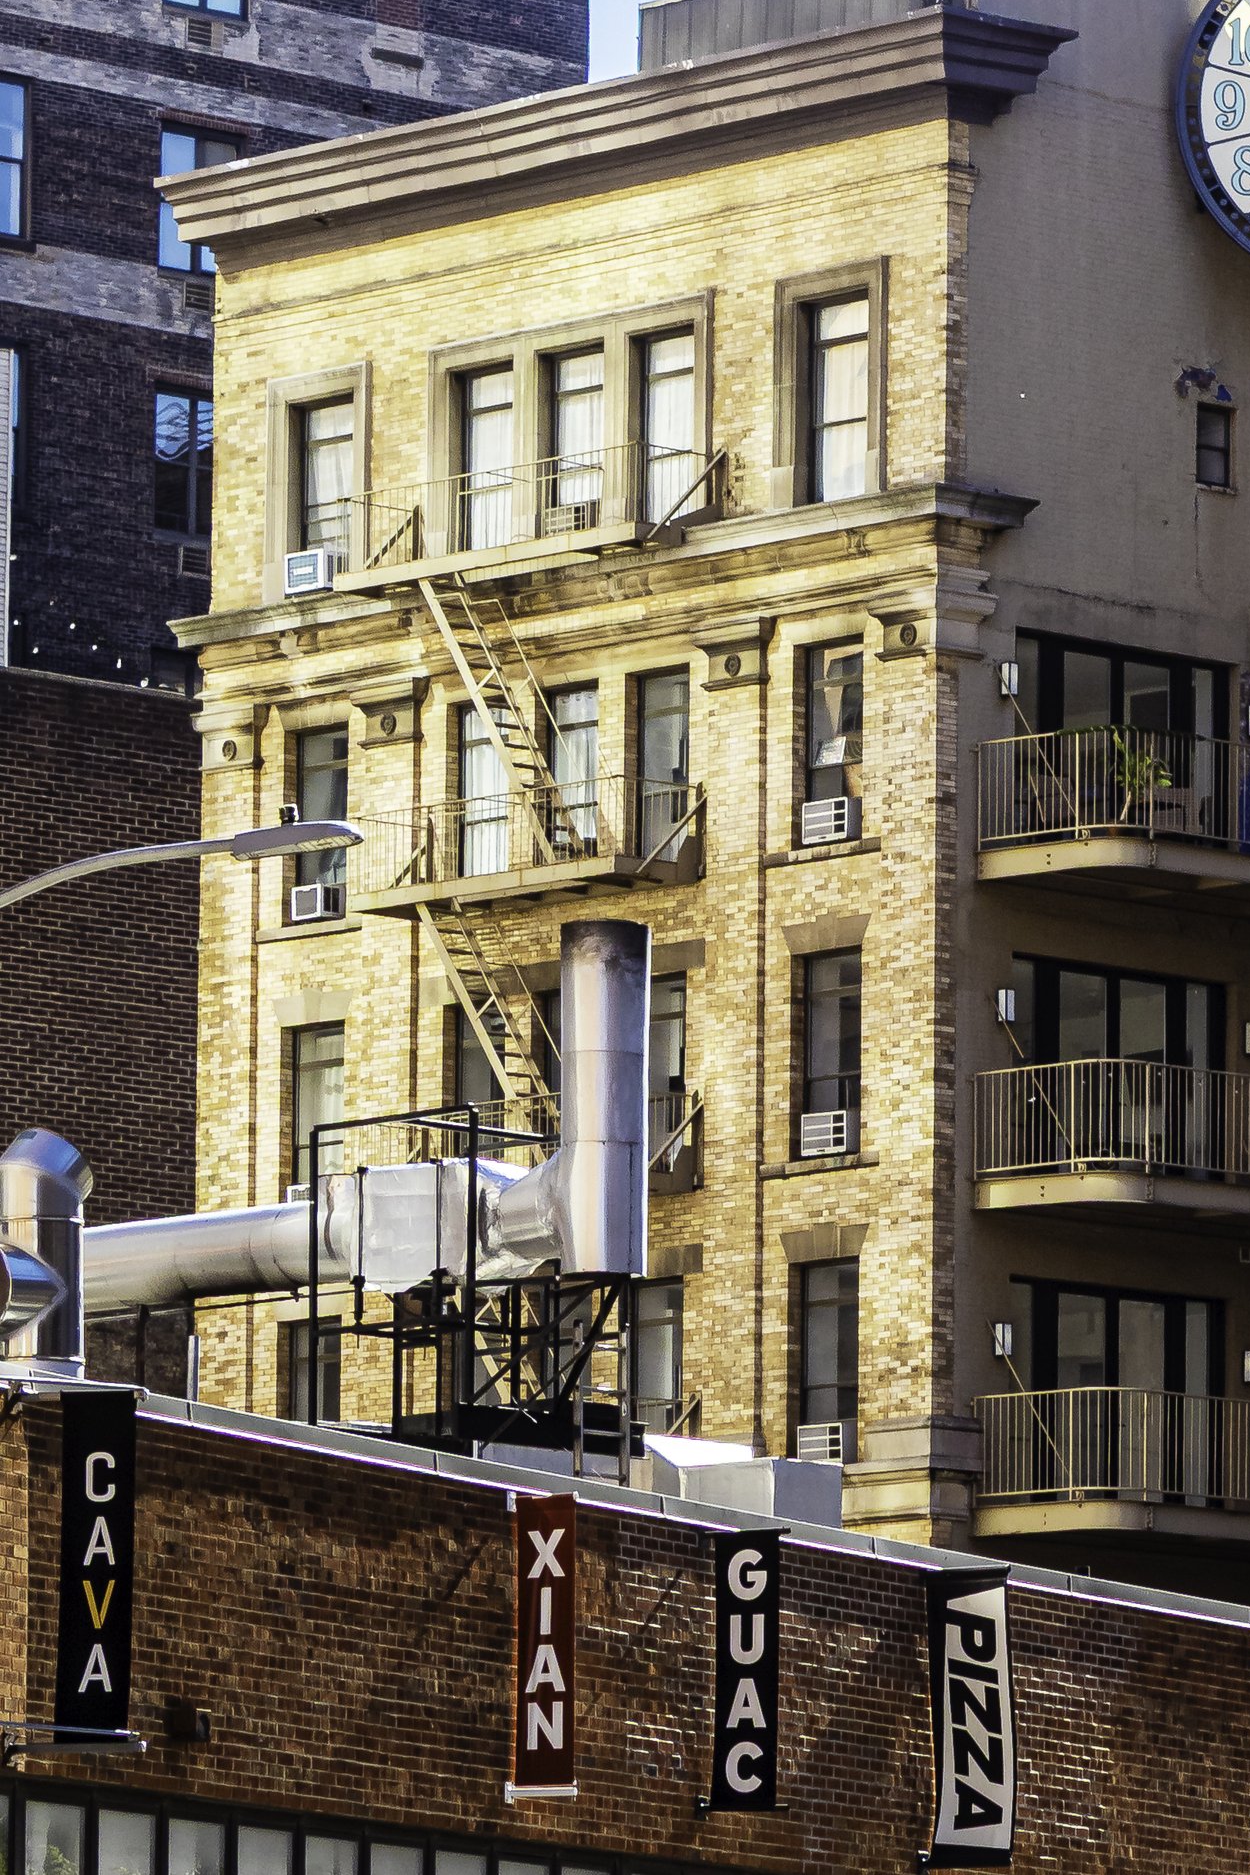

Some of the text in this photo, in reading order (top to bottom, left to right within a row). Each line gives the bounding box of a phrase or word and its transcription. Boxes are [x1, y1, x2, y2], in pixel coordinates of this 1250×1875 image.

[1213, 80, 1246, 131] 9
[78, 1451, 116, 1694] CAVA
[525, 1528, 567, 1751] XIAN
[726, 1548, 768, 1794] GUAC
[945, 1611, 1005, 1831] PIZZA
